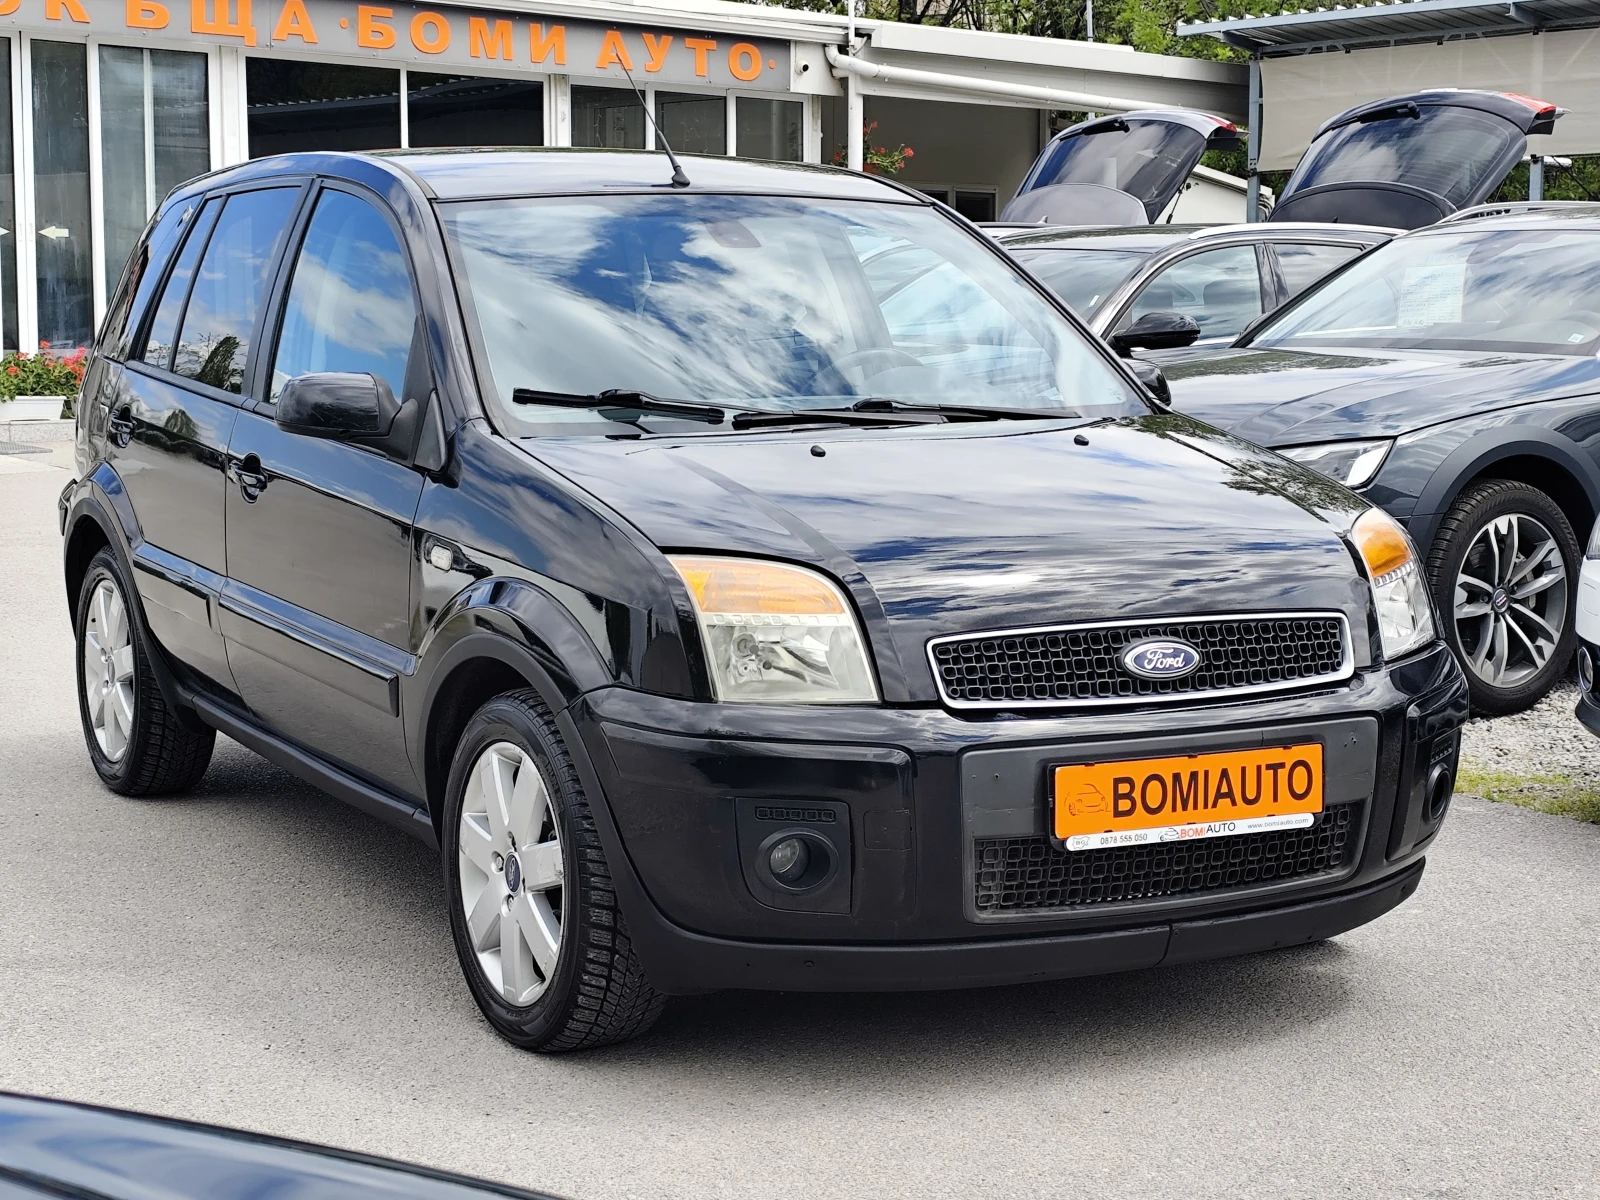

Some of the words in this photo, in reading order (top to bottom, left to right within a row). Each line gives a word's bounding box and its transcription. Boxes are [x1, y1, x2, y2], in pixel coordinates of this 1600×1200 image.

[357, 5, 567, 65] БОМИ
[597, 30, 763, 81] АУТО
[1144, 648, 1185, 670] Ford
[1112, 759, 1313, 819] BOMIAUTO
[1247, 818, 1309, 829] www.bomiauto.com
[1100, 835, 1118, 845] 0878
[1119, 834, 1133, 843] 555
[1134, 833, 1148, 842] 050
